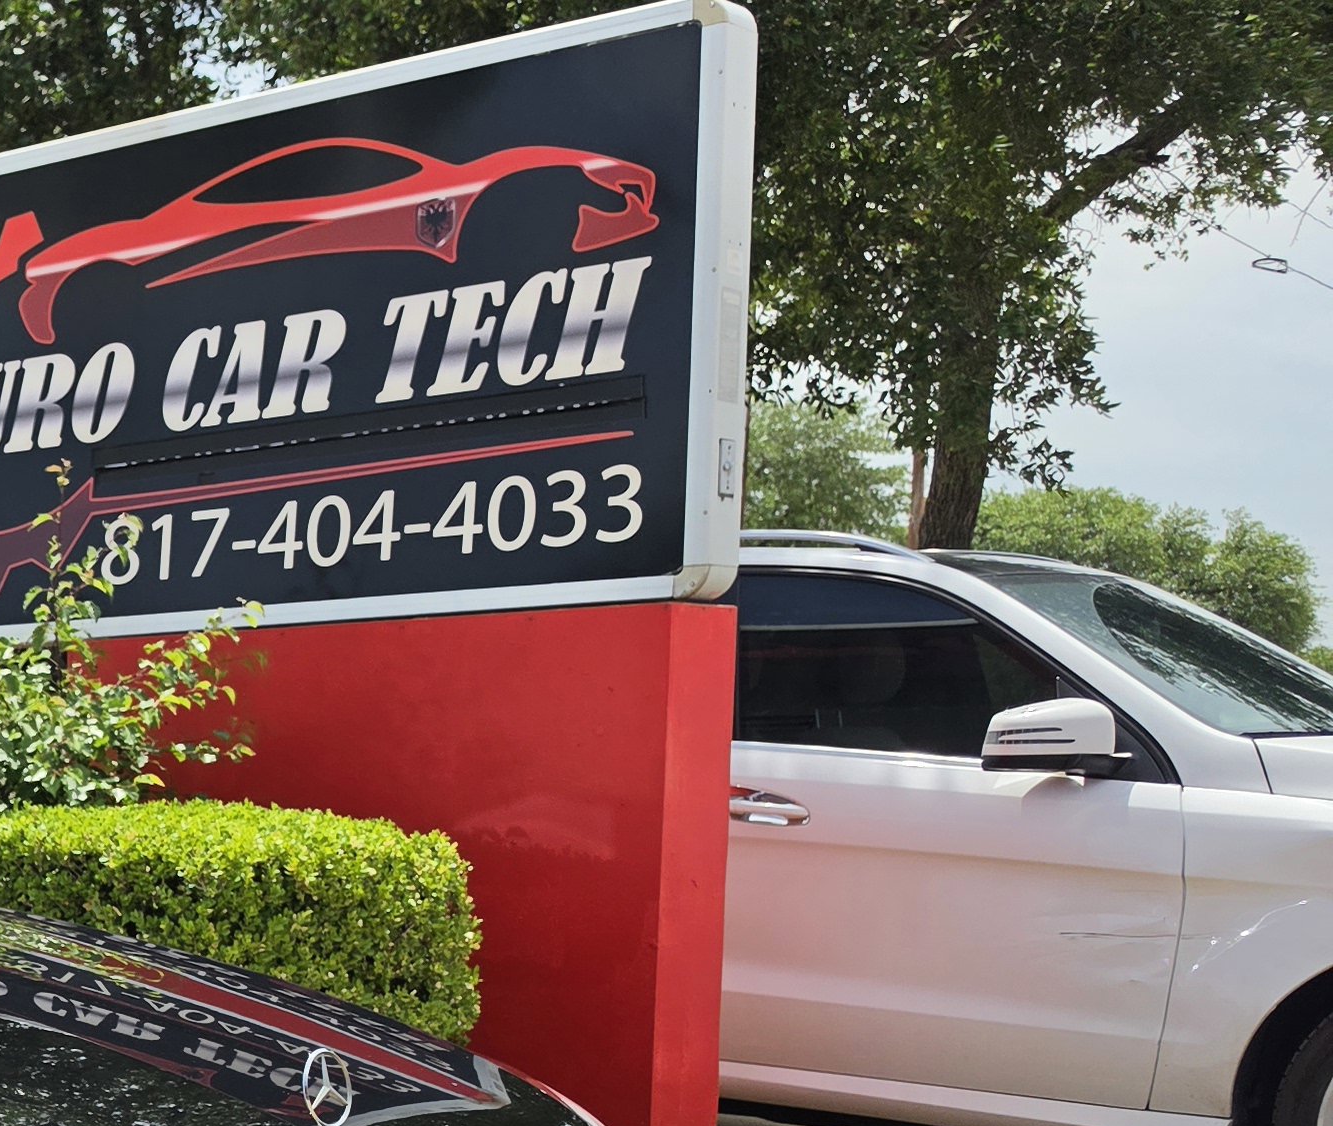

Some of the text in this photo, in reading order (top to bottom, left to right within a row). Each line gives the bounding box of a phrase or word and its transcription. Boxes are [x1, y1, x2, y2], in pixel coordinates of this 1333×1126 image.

[161, 308, 347, 432] CAR
[375, 256, 653, 404] TECH
[100, 463, 645, 586] 817-404-4033
